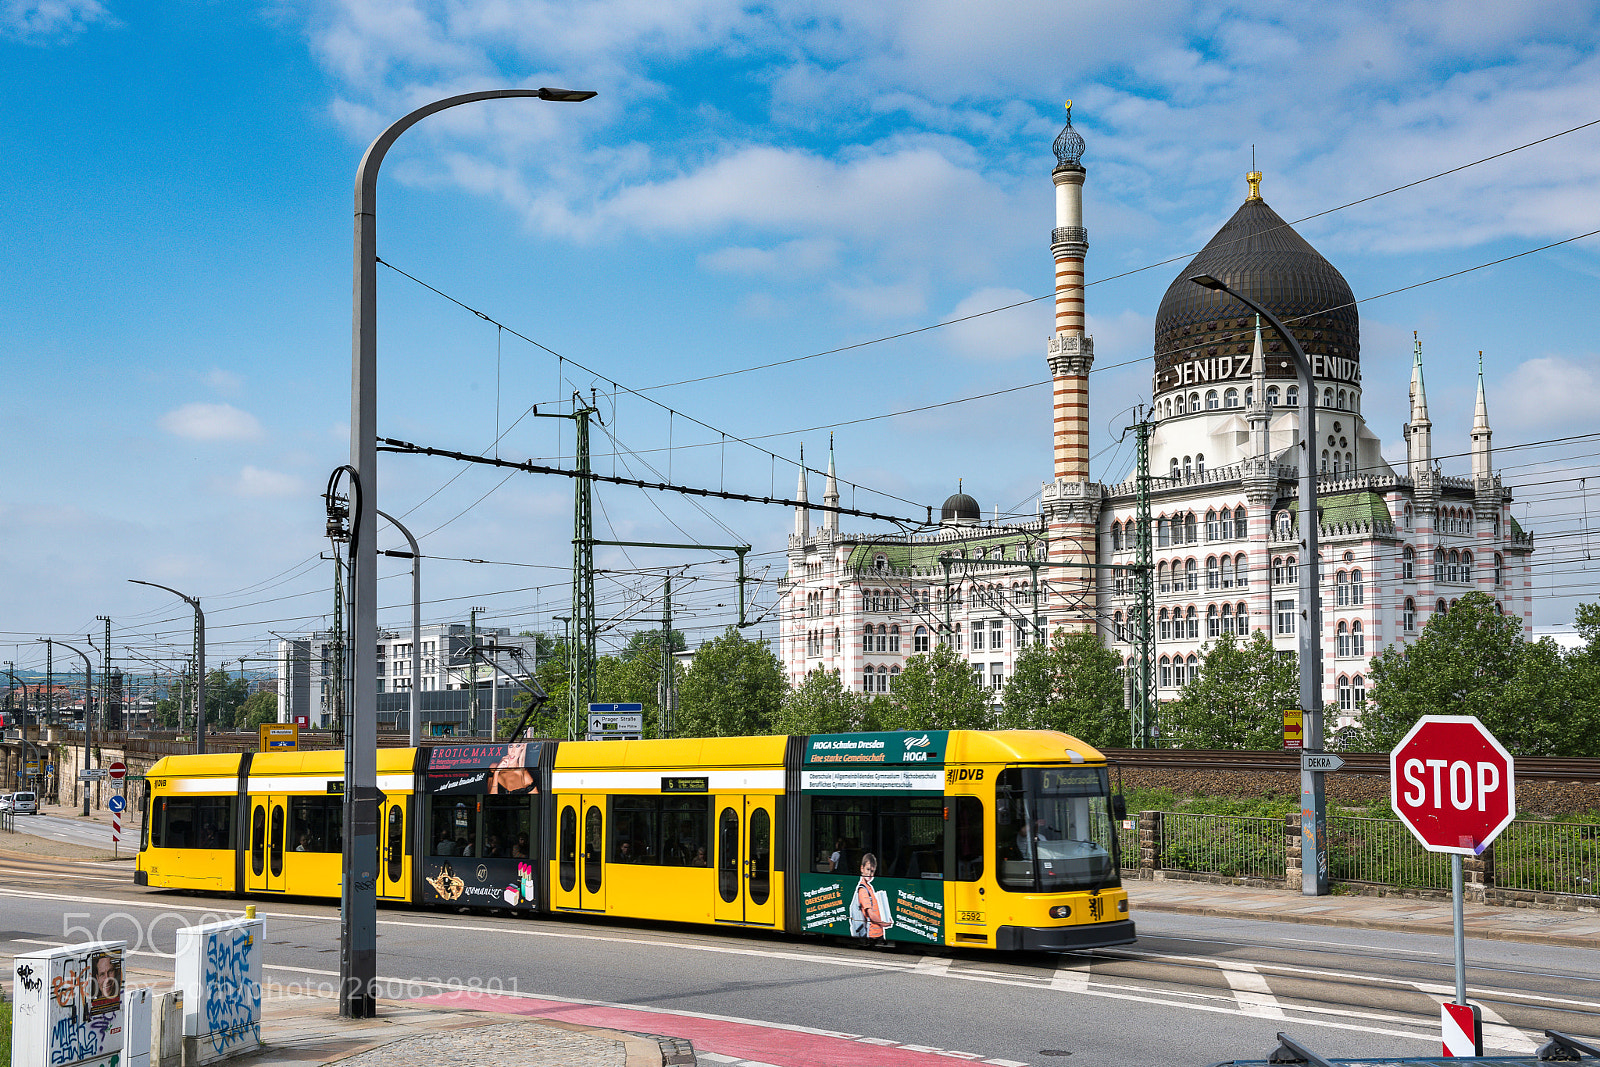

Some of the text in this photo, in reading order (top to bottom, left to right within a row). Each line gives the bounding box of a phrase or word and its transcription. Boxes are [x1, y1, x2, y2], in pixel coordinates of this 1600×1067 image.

[1174, 354, 1251, 387] YENIDZ
[813, 740, 885, 750] HOGA Schulen Dresden
[431, 746, 503, 758] EROTIC MAXX
[810, 752, 886, 763] Eine starke Gemeinschaft
[902, 752, 927, 762] HOGA
[1308, 757, 1332, 768] DEKRA
[958, 769, 984, 781] DVB
[1043, 771, 1050, 789] 6
[1403, 758, 1500, 812] STOP
[961, 912, 981, 921] 2592
